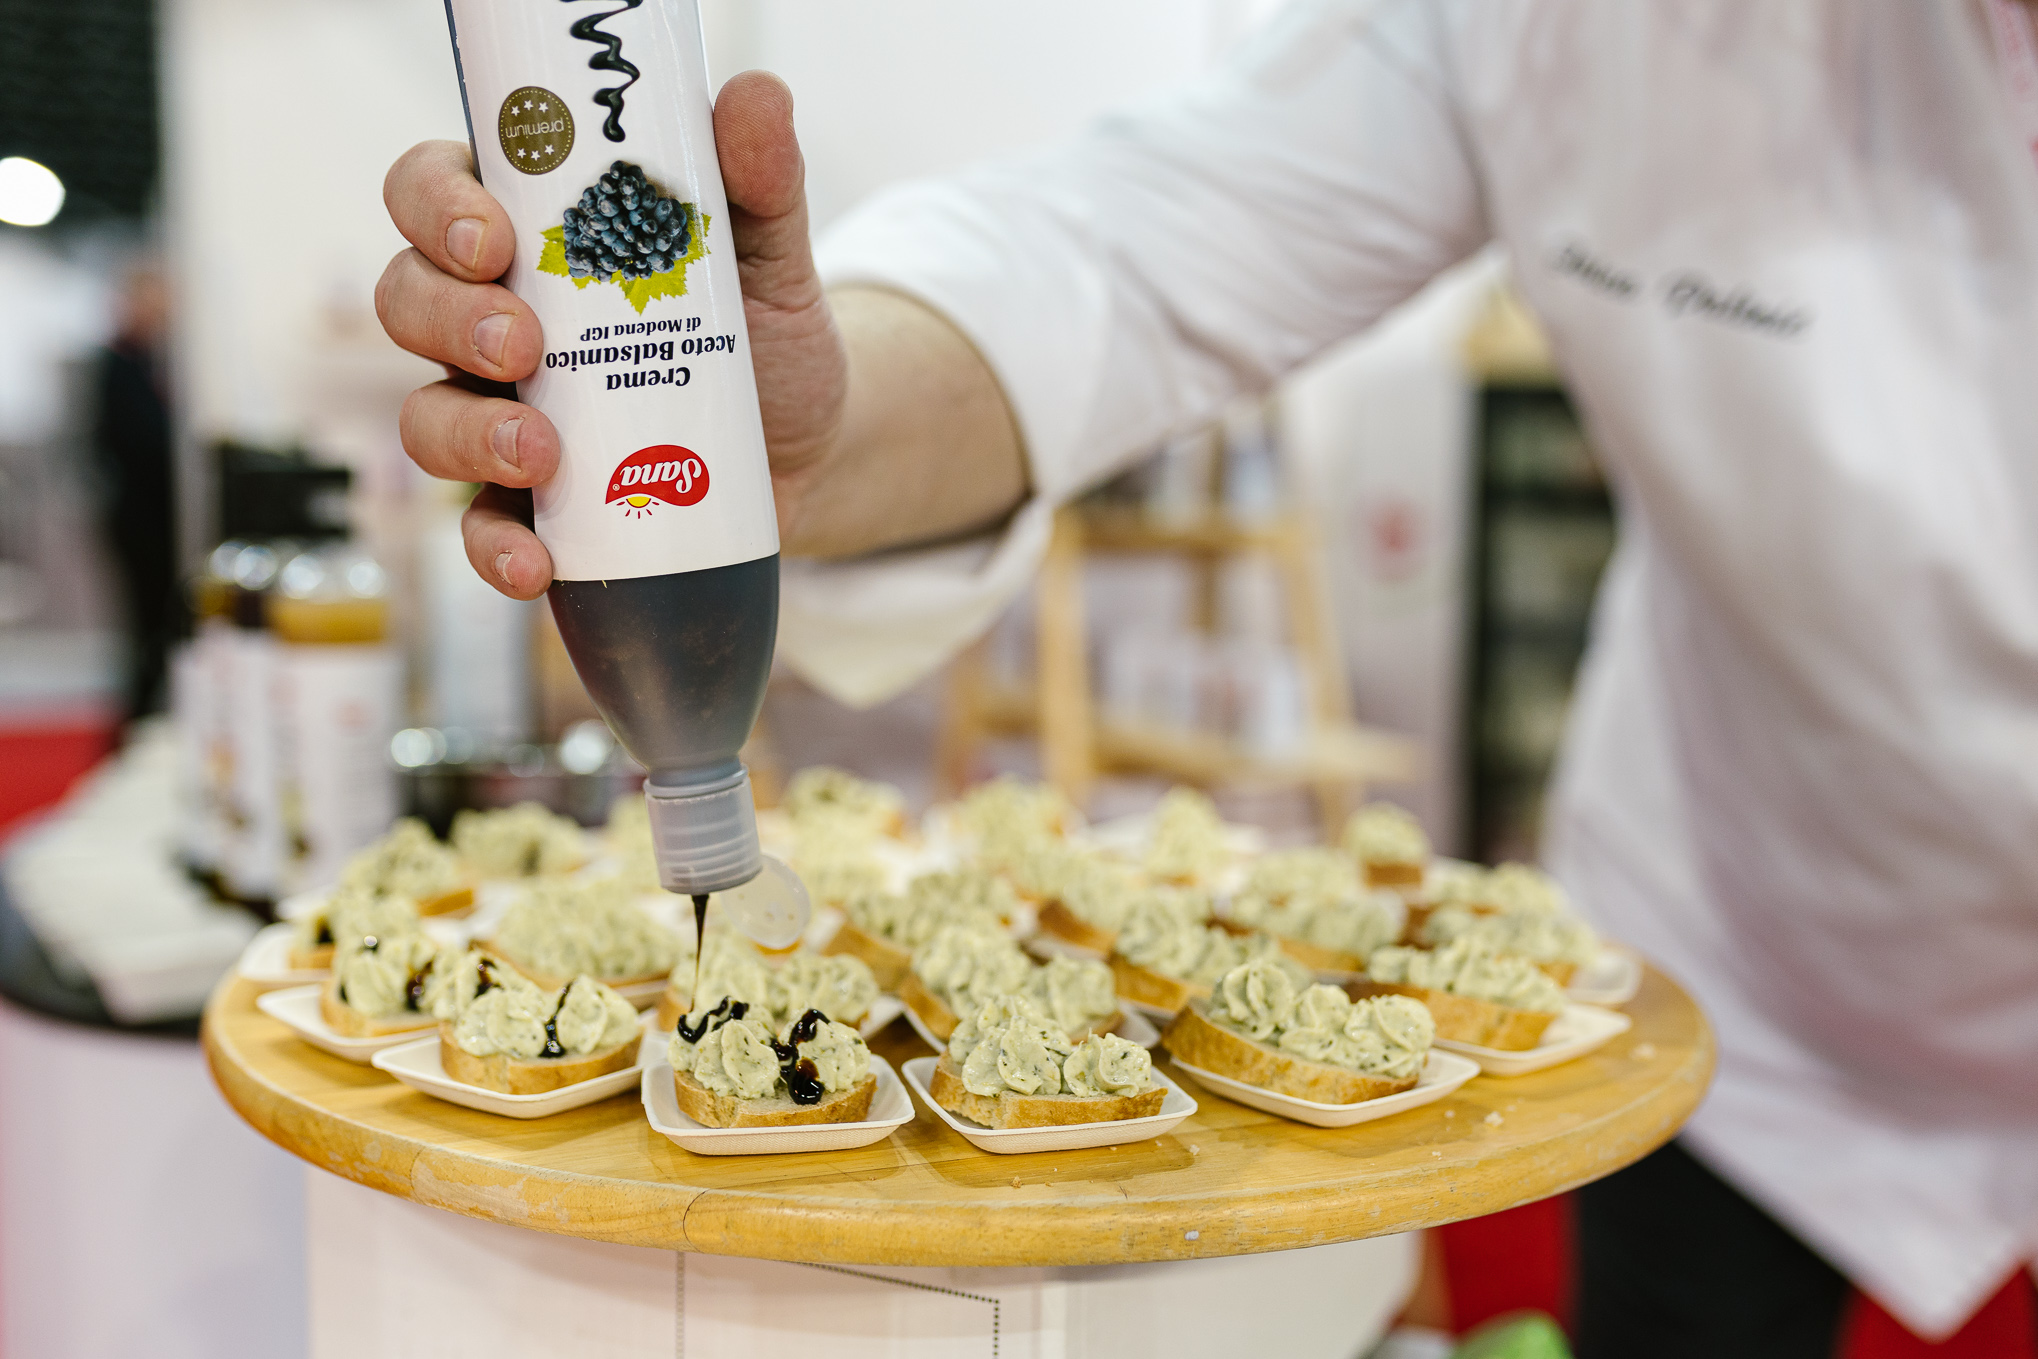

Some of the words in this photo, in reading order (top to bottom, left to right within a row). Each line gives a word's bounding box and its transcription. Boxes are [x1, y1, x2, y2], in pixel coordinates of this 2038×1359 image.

[505, 117, 565, 139] premium
[580, 326, 609, 342] IGP
[614, 319, 682, 336] Modena
[686, 316, 702, 332] di
[681, 335, 736, 356] Aceto
[545, 341, 674, 372] Balsamico
[606, 366, 691, 390] Crema
[620, 458, 702, 494] Sana
